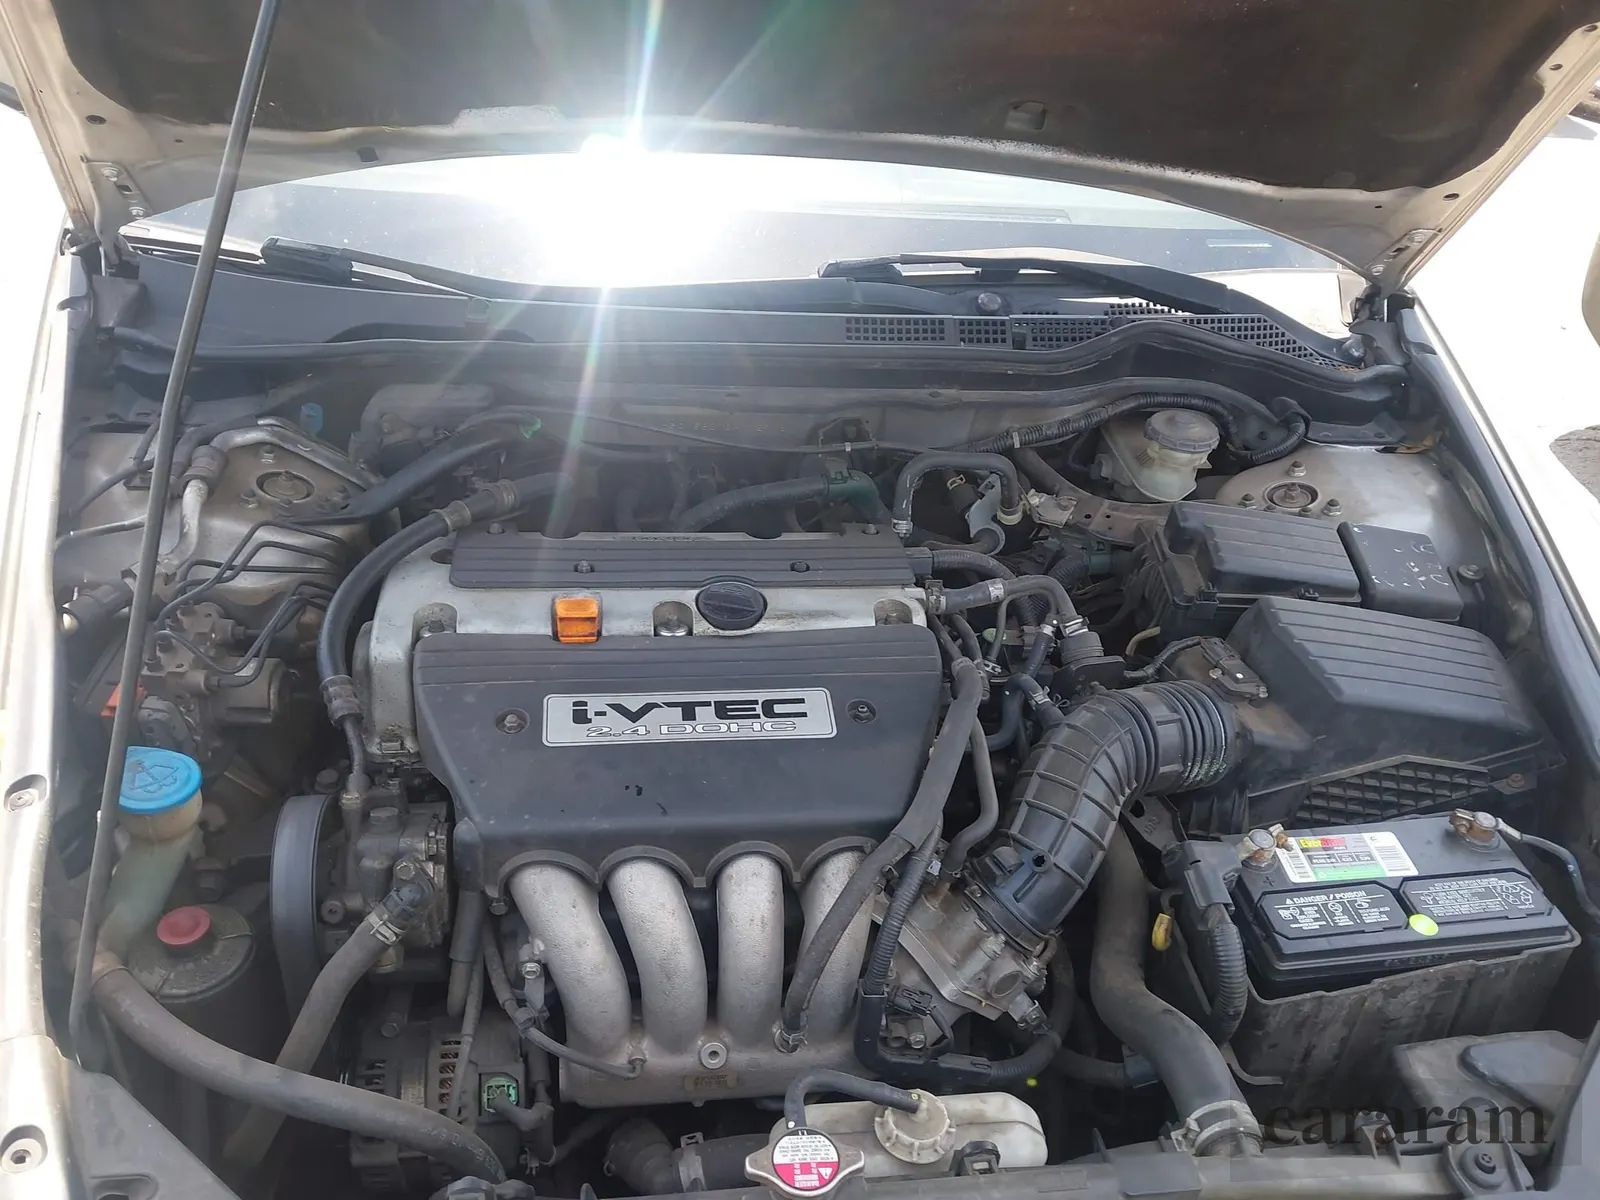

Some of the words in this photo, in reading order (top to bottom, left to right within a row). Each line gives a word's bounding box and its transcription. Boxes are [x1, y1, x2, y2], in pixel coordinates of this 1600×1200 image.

[572, 698, 808, 724] i-VTEC
[586, 725, 650, 738] 2.4
[660, 720, 797, 735] DOHC
[1293, 894, 1329, 904] DANGER
[1335, 890, 1367, 900] POISON
